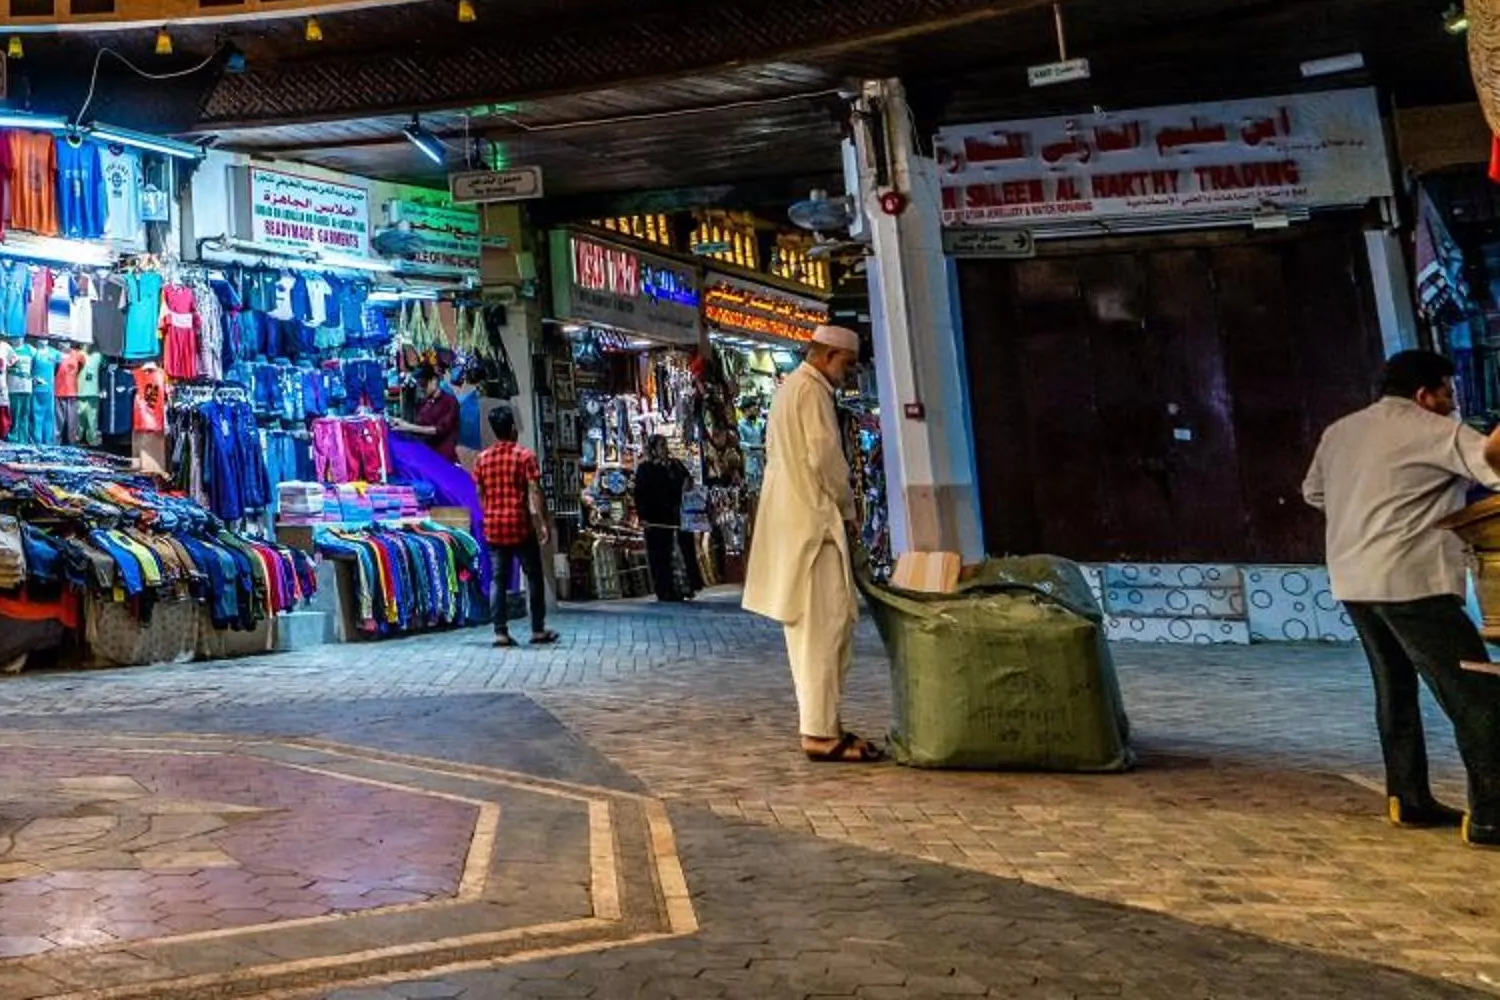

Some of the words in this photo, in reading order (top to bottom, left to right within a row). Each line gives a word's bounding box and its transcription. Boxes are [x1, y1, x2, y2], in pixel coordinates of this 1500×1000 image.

[1057, 178, 1080, 200] AL
[1195, 160, 1299, 190] TRADING
[264, 190, 312, 208] الجاهزة
[315, 204, 356, 216] الملابس
[265, 220, 313, 241] READYMADE
[317, 227, 359, 249] GARMENTS
